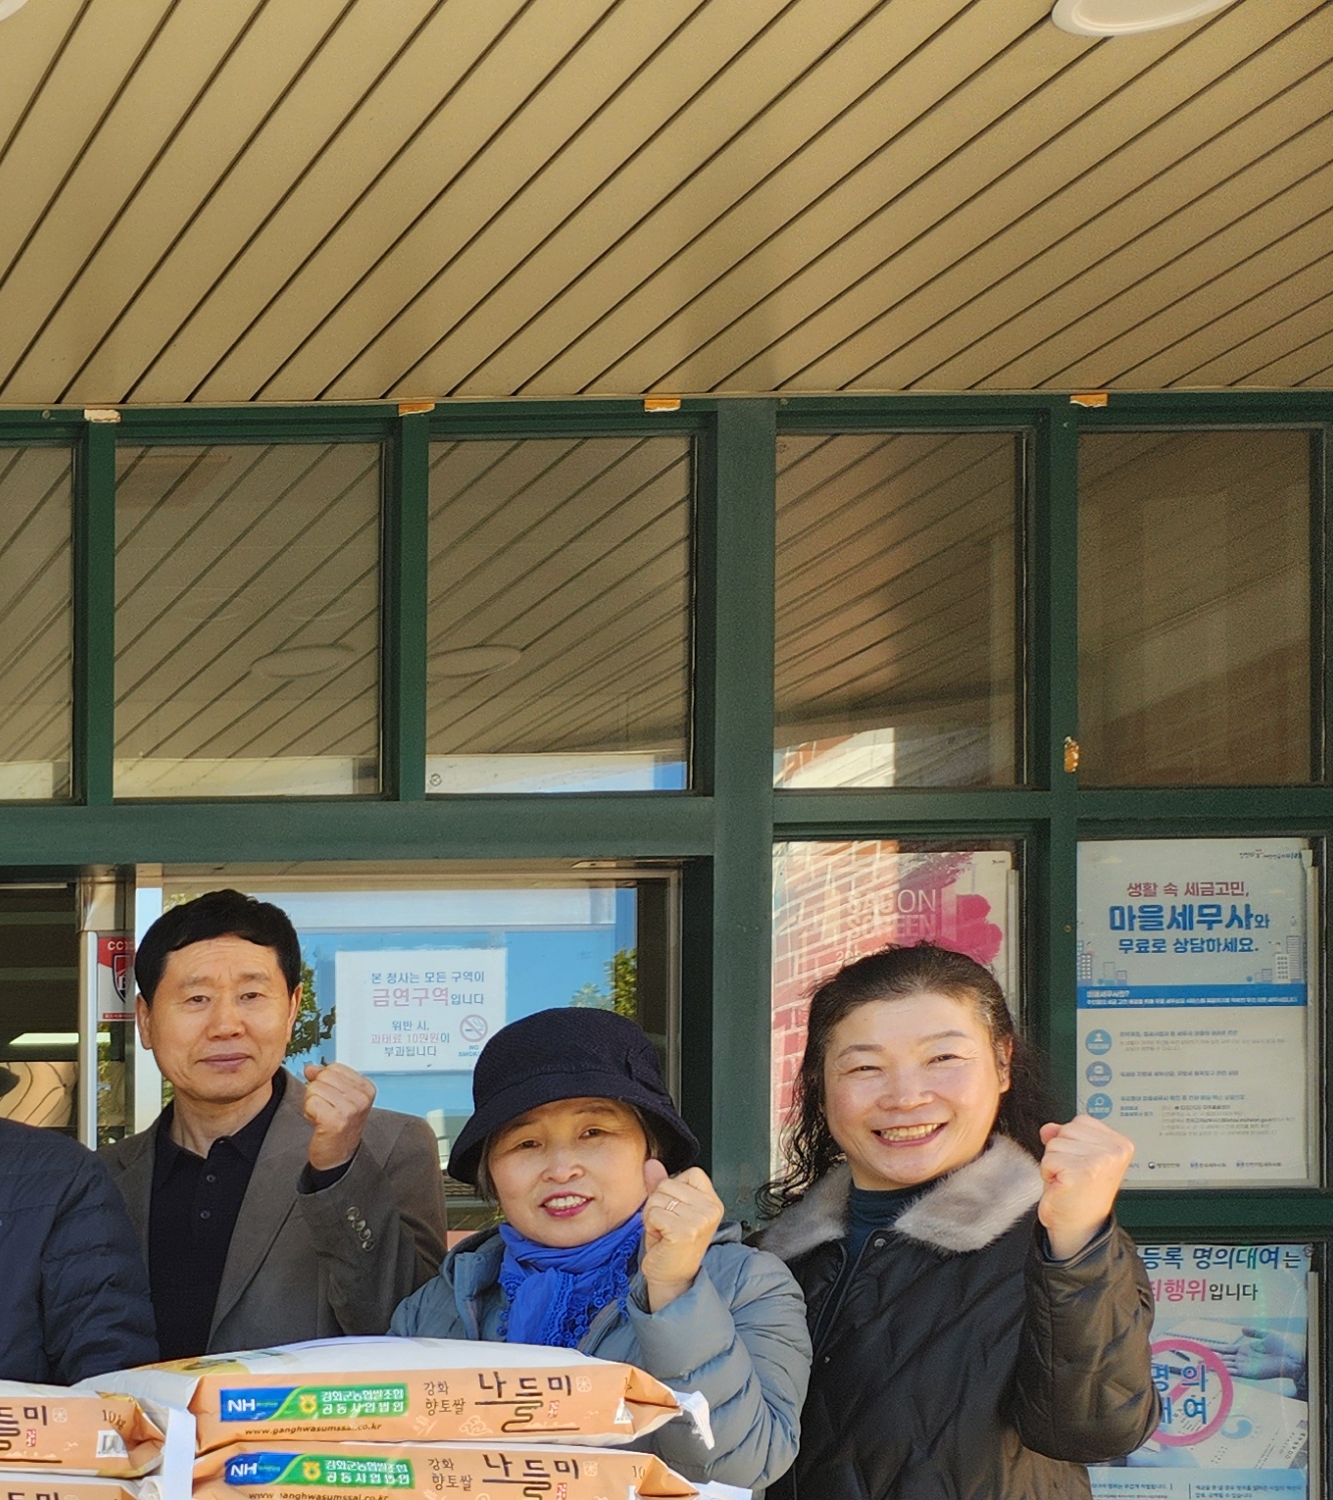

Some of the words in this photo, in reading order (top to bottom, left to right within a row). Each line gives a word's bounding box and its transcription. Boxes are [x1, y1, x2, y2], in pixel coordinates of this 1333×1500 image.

[1127, 882, 1157, 898] 생활
[1163, 882, 1178, 898] 속
[1184, 881, 1250, 898] 세금고민,
[1109, 903, 1270, 931] 마을세무사와
[1118, 938, 1167, 954] 무료로
[1173, 937, 1259, 953] 상담하세요.
[371, 972, 382, 984] 본
[387, 972, 420, 984] 청사는
[425, 971, 447, 983] 모든
[451, 971, 485, 983] 구역이
[373, 987, 485, 1007] 금연구역입니다
[392, 1020, 413, 1031] 위반
[384, 1046, 437, 1057] 부과됩니다
[1193, 1246, 1301, 1270] 명의대여는
[424, 1381, 449, 1394] 강화
[227, 1399, 255, 1412] NH
[322, 1400, 404, 1414] 공동사업법인
[425, 1399, 465, 1415] 향토쌀
